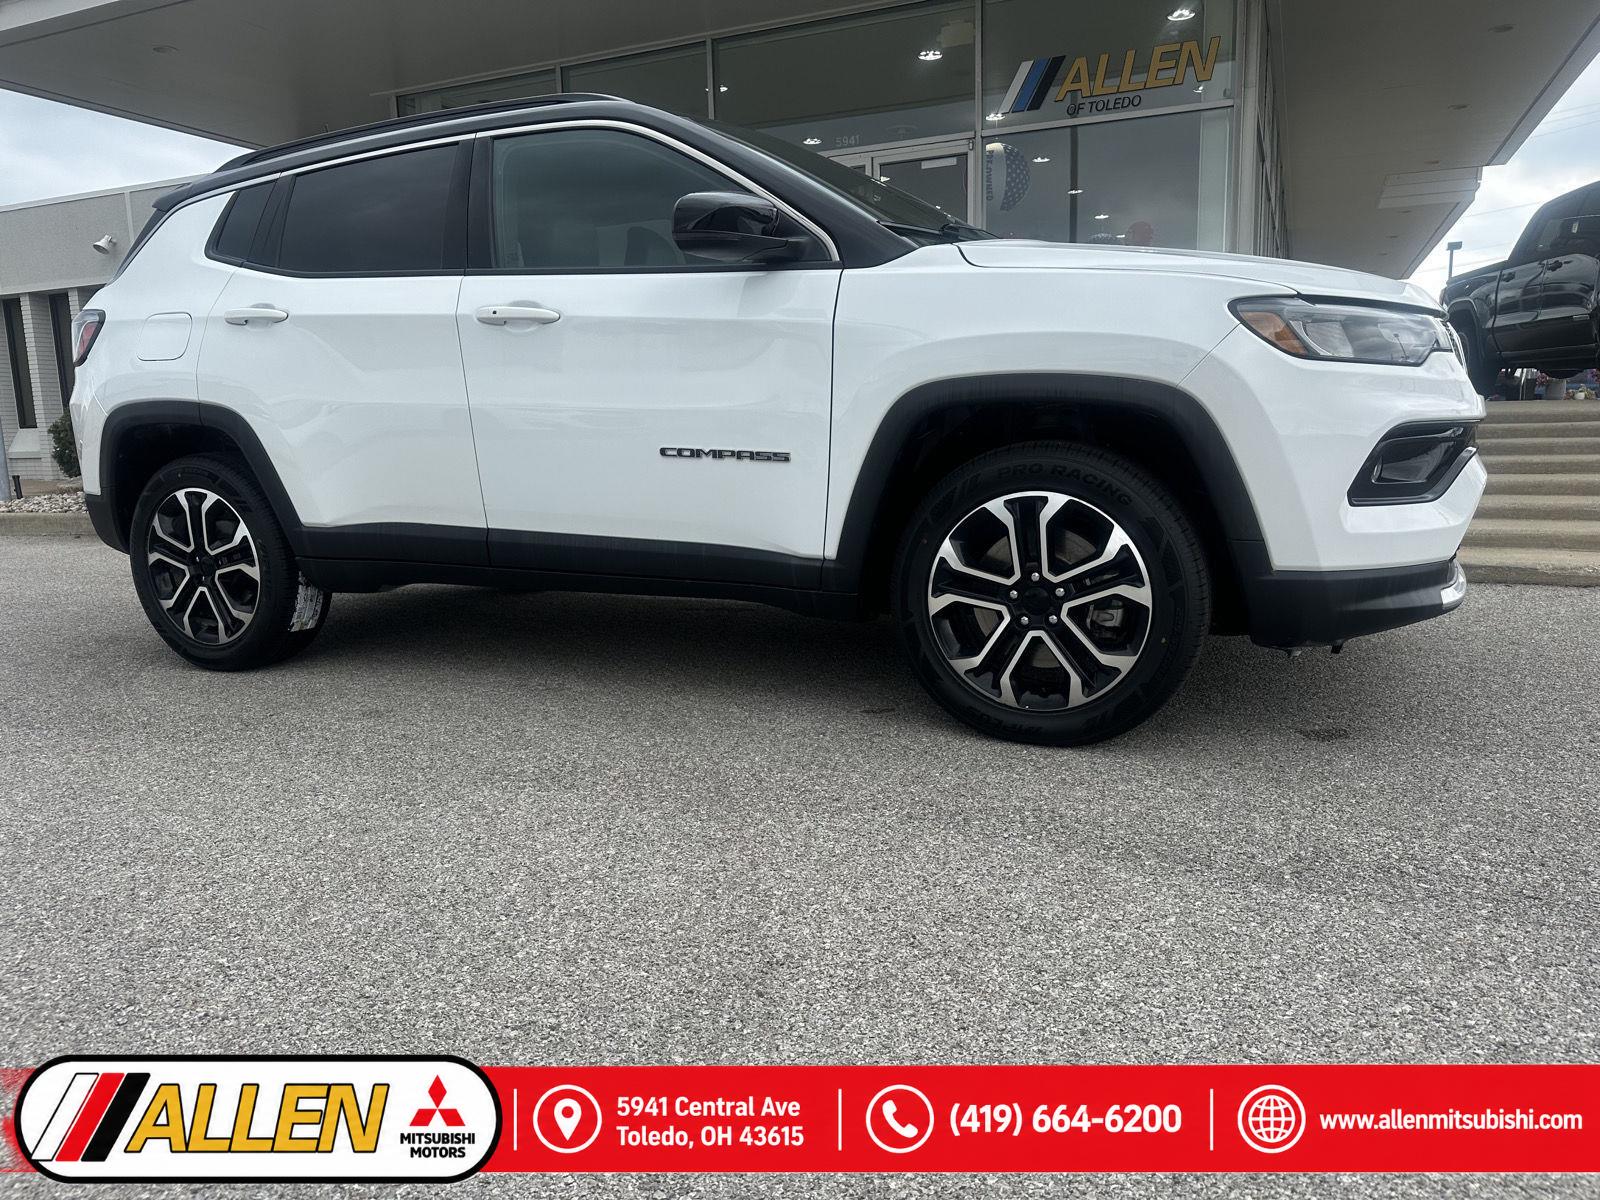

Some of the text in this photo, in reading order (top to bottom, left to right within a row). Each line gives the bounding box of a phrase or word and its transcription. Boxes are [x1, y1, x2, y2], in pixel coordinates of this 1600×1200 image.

[1054, 36, 1221, 102] ALLEN
[1066, 95, 1142, 116] OF TOLEDO
[659, 446, 791, 463] COMPASS
[1050, 464, 1132, 506] RACING
